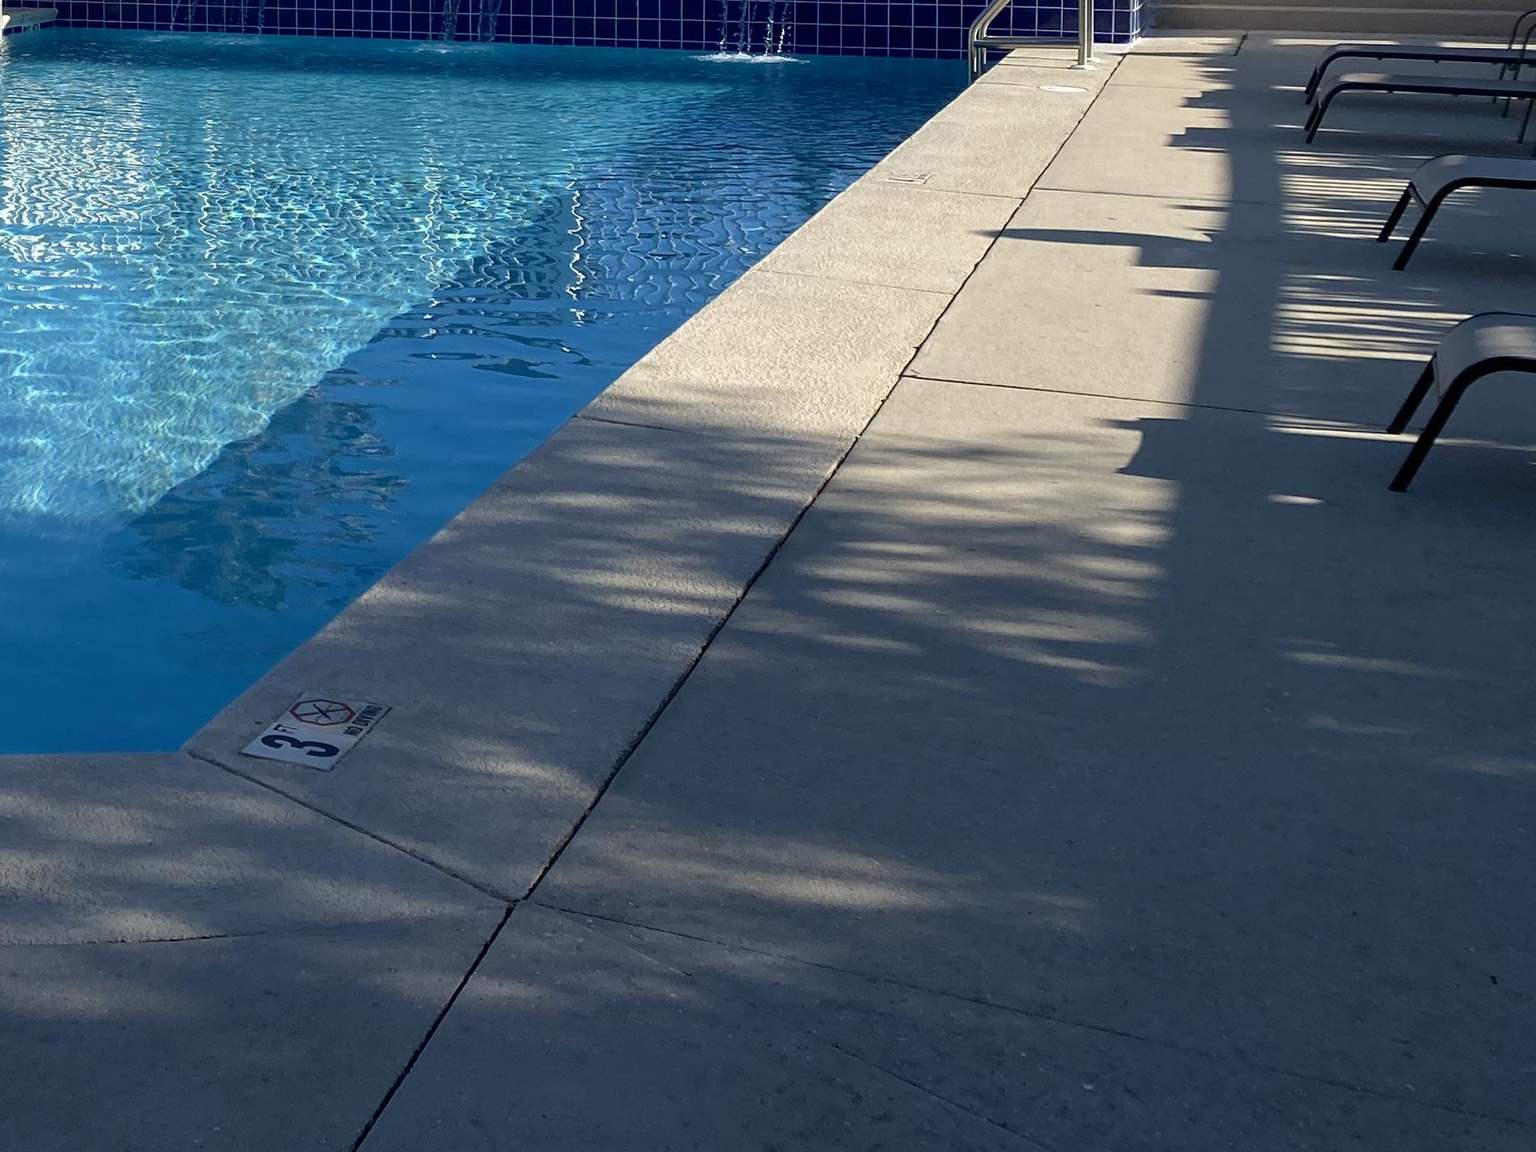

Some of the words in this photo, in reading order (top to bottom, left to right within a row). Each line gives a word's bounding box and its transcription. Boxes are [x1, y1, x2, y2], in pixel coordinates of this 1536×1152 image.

[272, 724, 297, 735] FT
[343, 725, 364, 737] NO
[261, 734, 340, 757] 3
